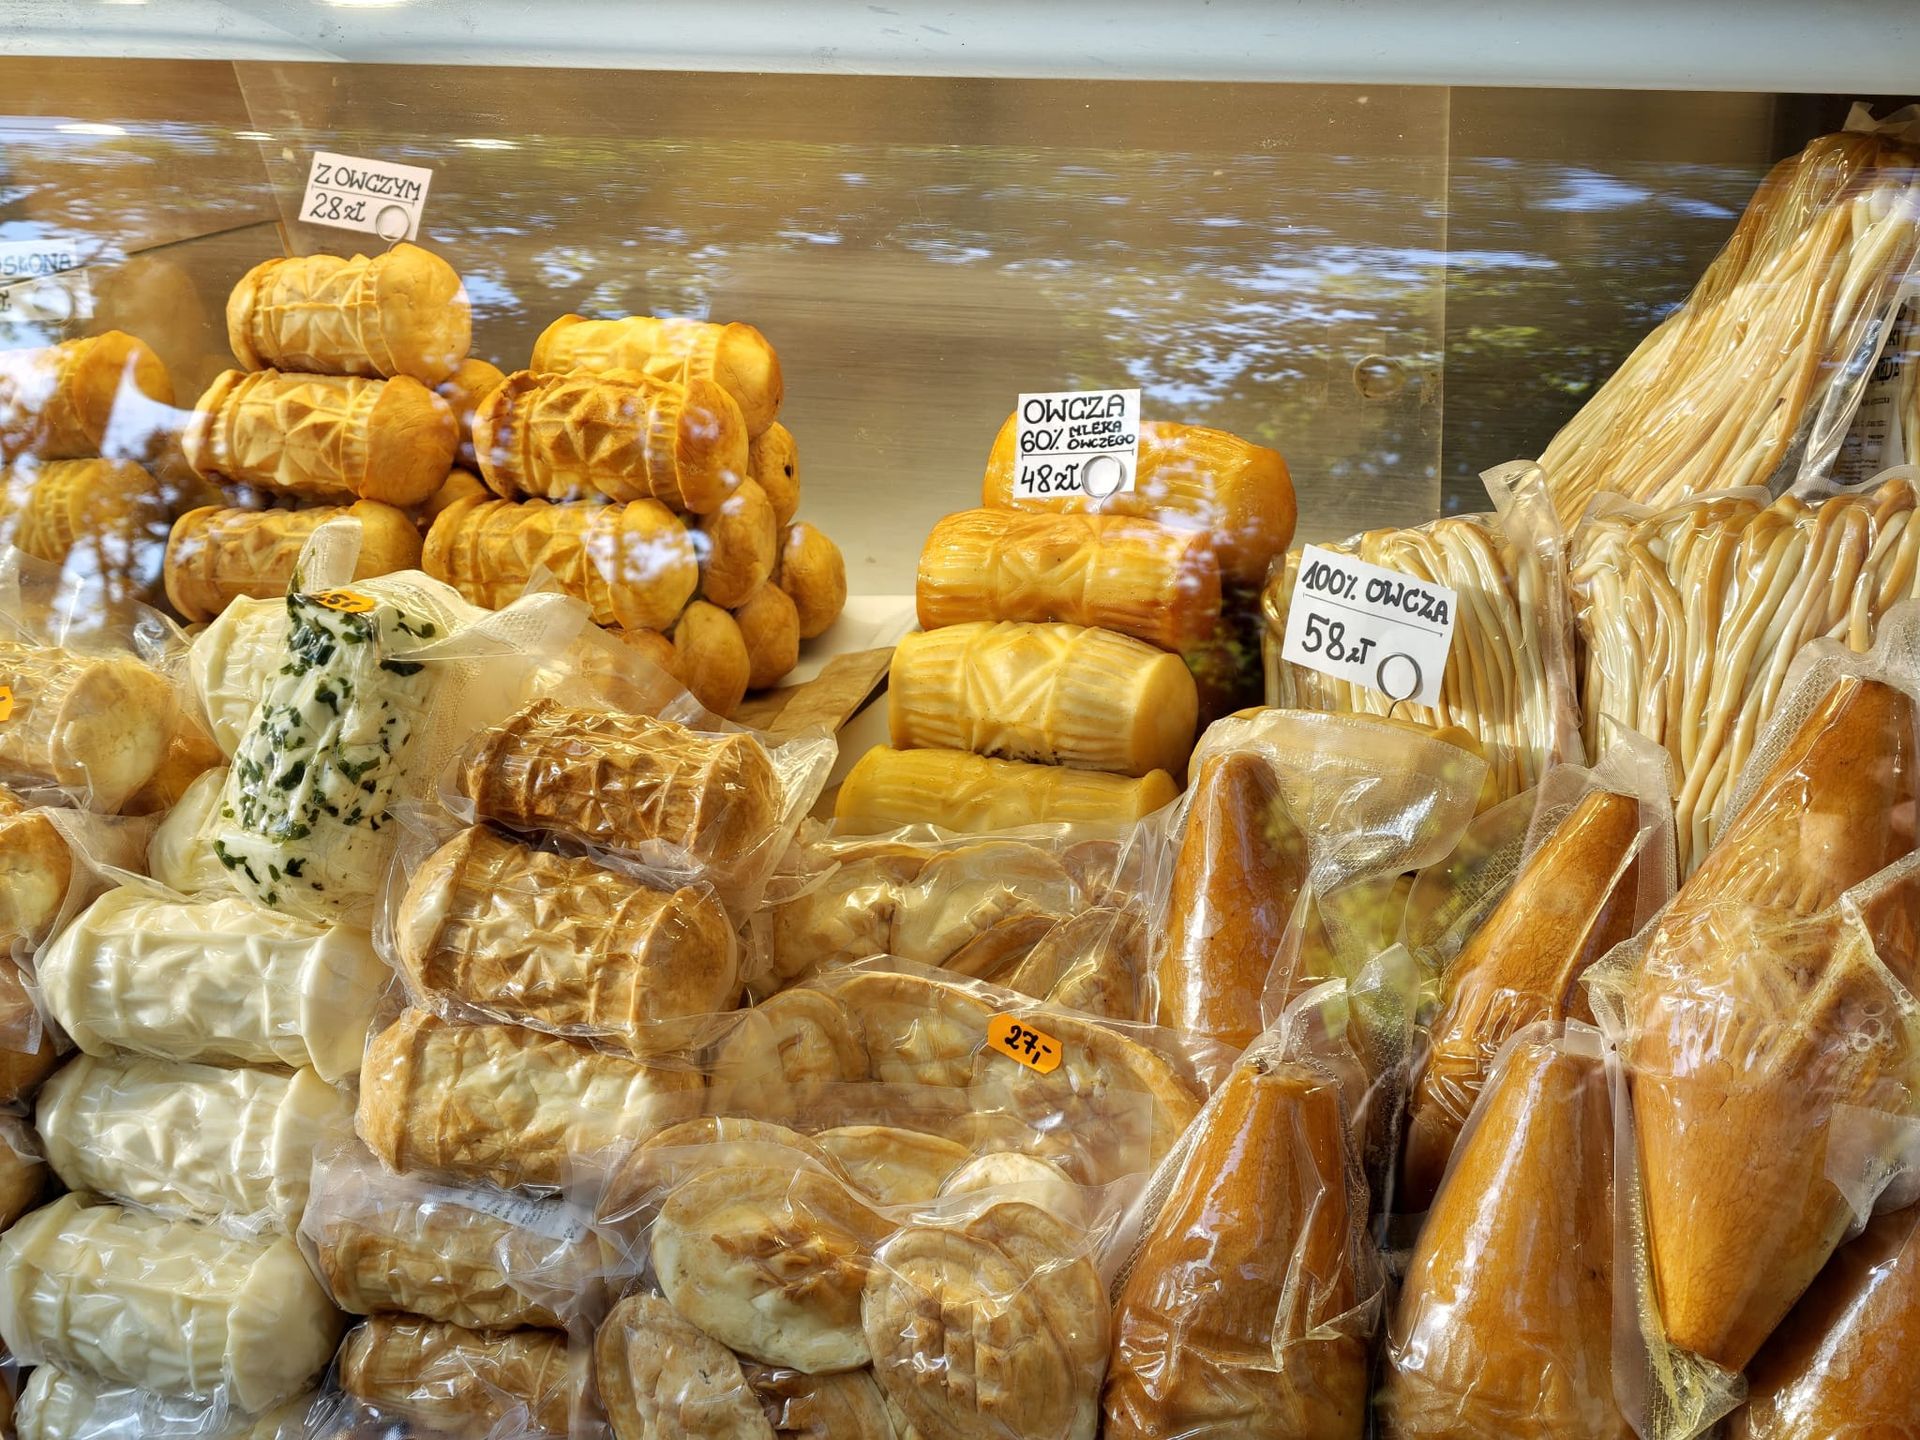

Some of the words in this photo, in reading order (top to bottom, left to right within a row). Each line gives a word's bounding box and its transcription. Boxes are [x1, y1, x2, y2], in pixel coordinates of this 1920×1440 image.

[314, 163, 332, 184] Z
[335, 167, 421, 200] OWCZYM
[1024, 394, 1125, 424] OWCZA
[1020, 428, 1064, 452] 60%
[1069, 420, 1122, 438] MLEKA
[1067, 434, 1135, 450] OWCZEGO
[1302, 561, 1358, 600] 100%
[1365, 578, 1449, 625] OWCZA
